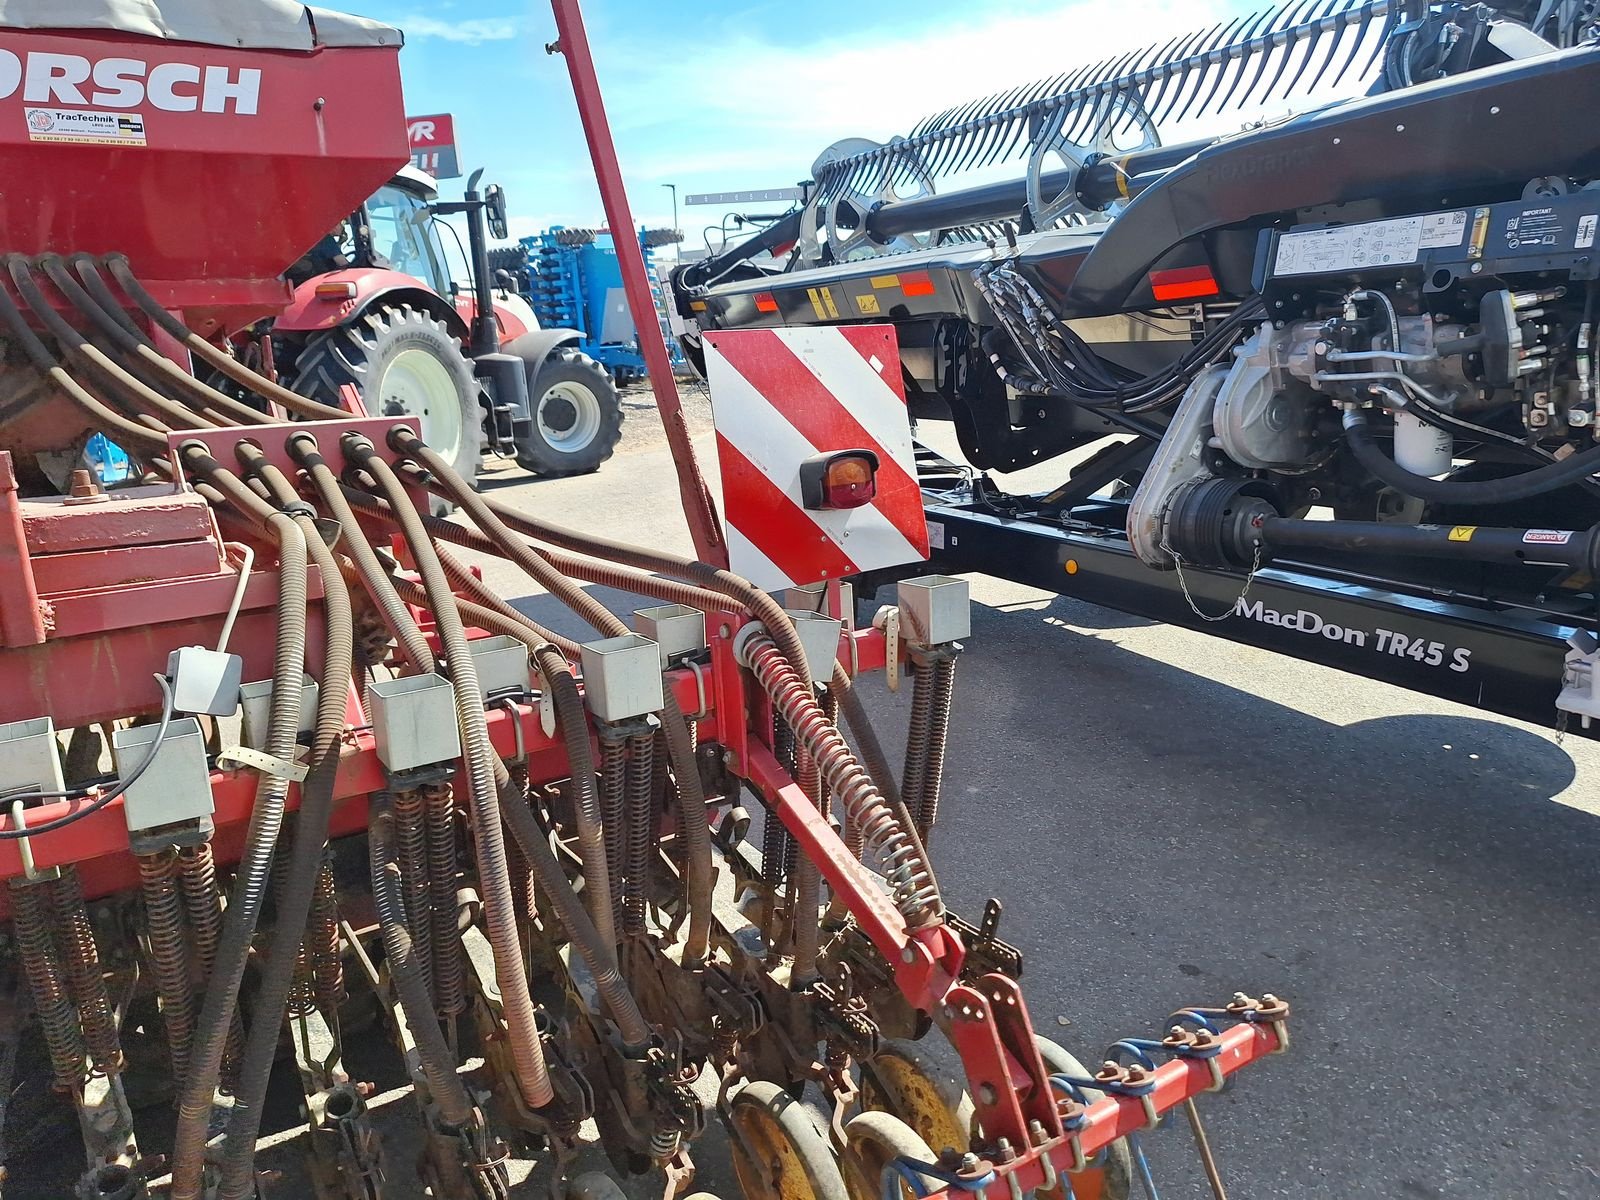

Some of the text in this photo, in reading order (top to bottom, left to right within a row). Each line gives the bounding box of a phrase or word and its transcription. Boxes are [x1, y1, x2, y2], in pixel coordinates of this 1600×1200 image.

[55, 112, 114, 123] TracTechnik
[1522, 207, 1553, 216] IMPORTANT
[1526, 533, 1558, 541] DANGER
[1235, 597, 1472, 673] MacDon TR45 S
